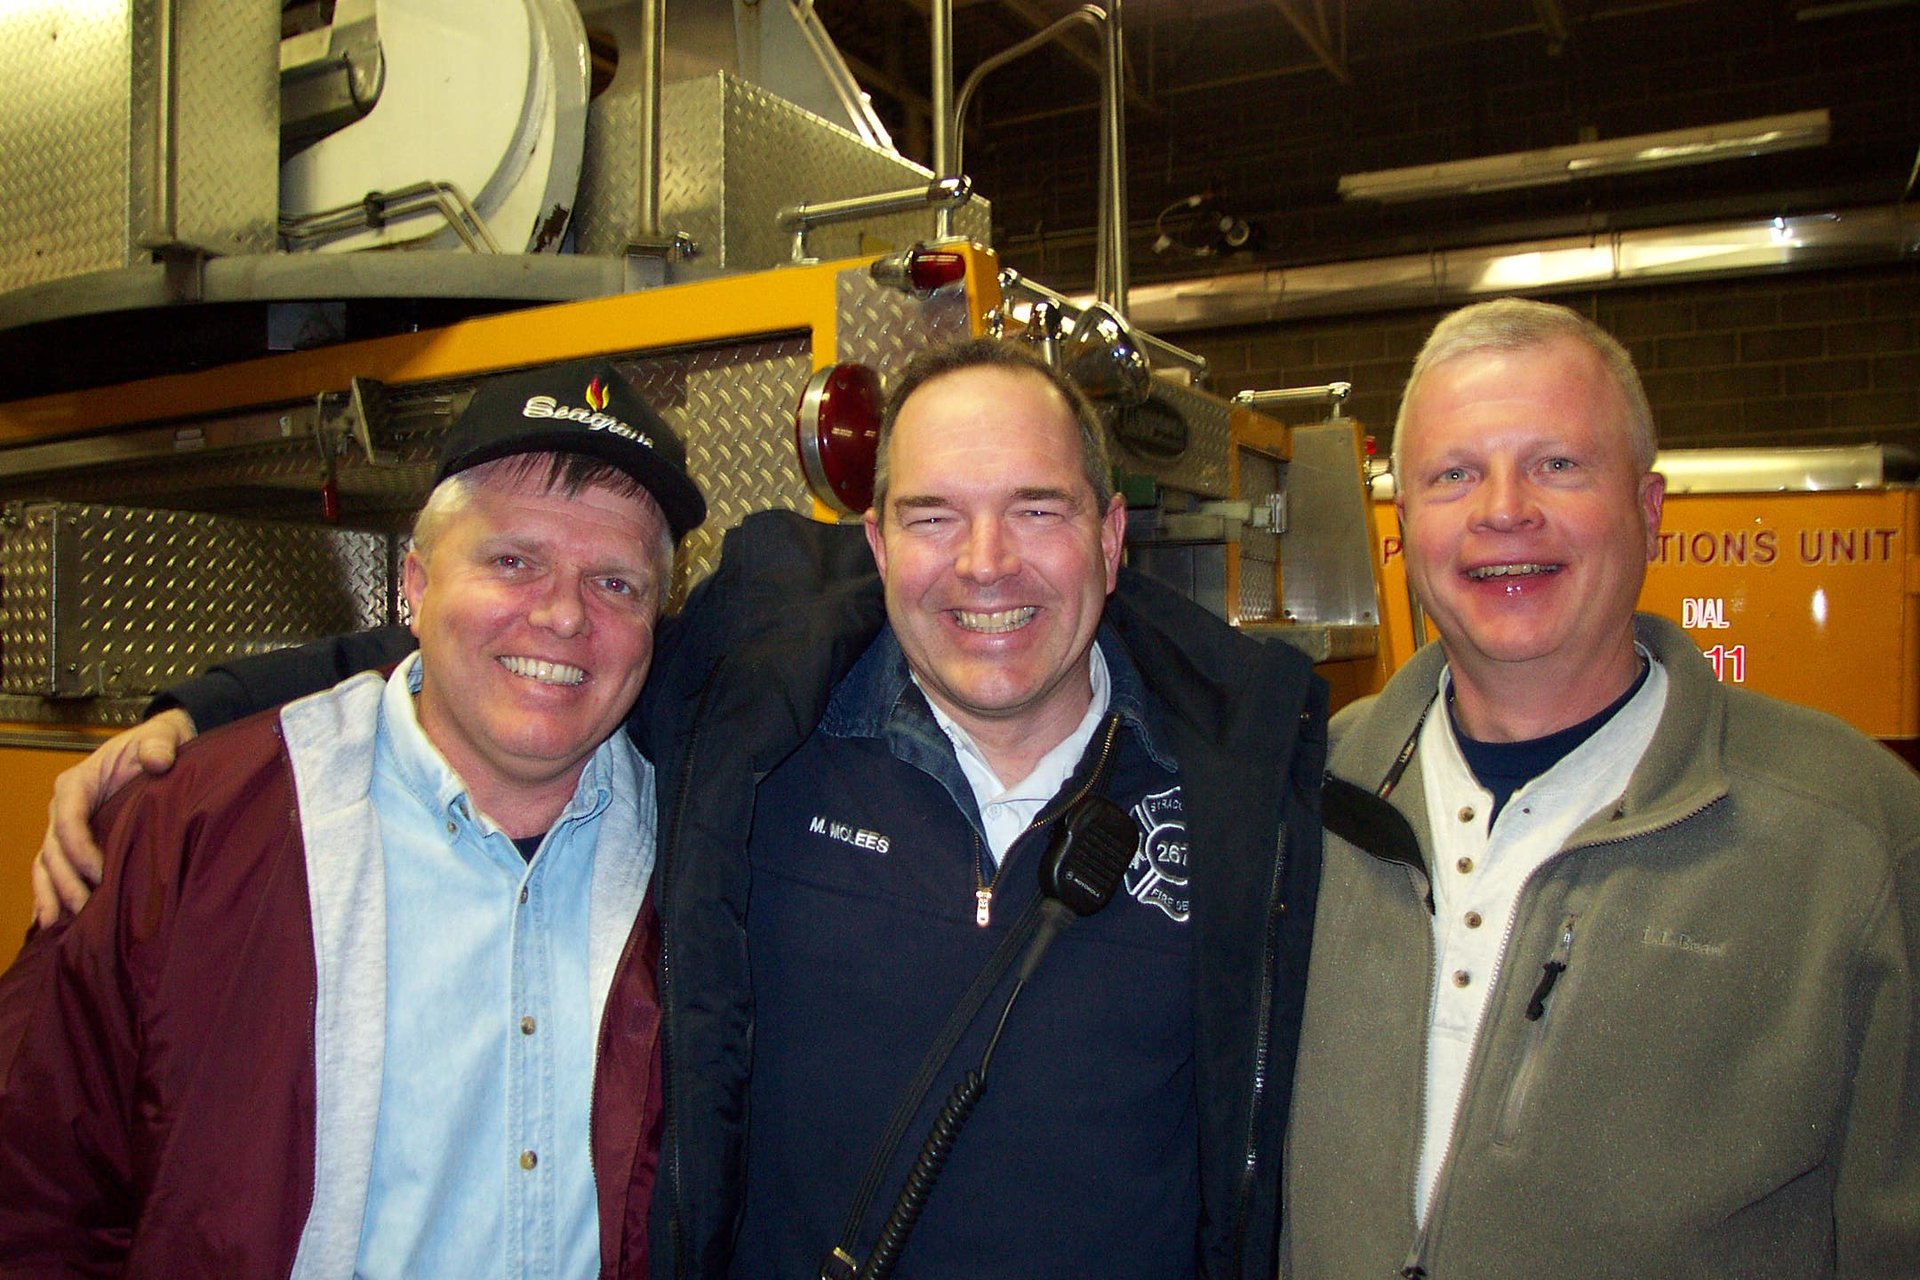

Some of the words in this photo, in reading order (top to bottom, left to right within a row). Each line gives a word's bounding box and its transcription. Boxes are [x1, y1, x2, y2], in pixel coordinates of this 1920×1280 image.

[1799, 527, 1900, 565] UNIT
[1682, 598, 1730, 629] DIAL
[809, 816, 826, 834] M.
[1156, 840, 1188, 867] 267
